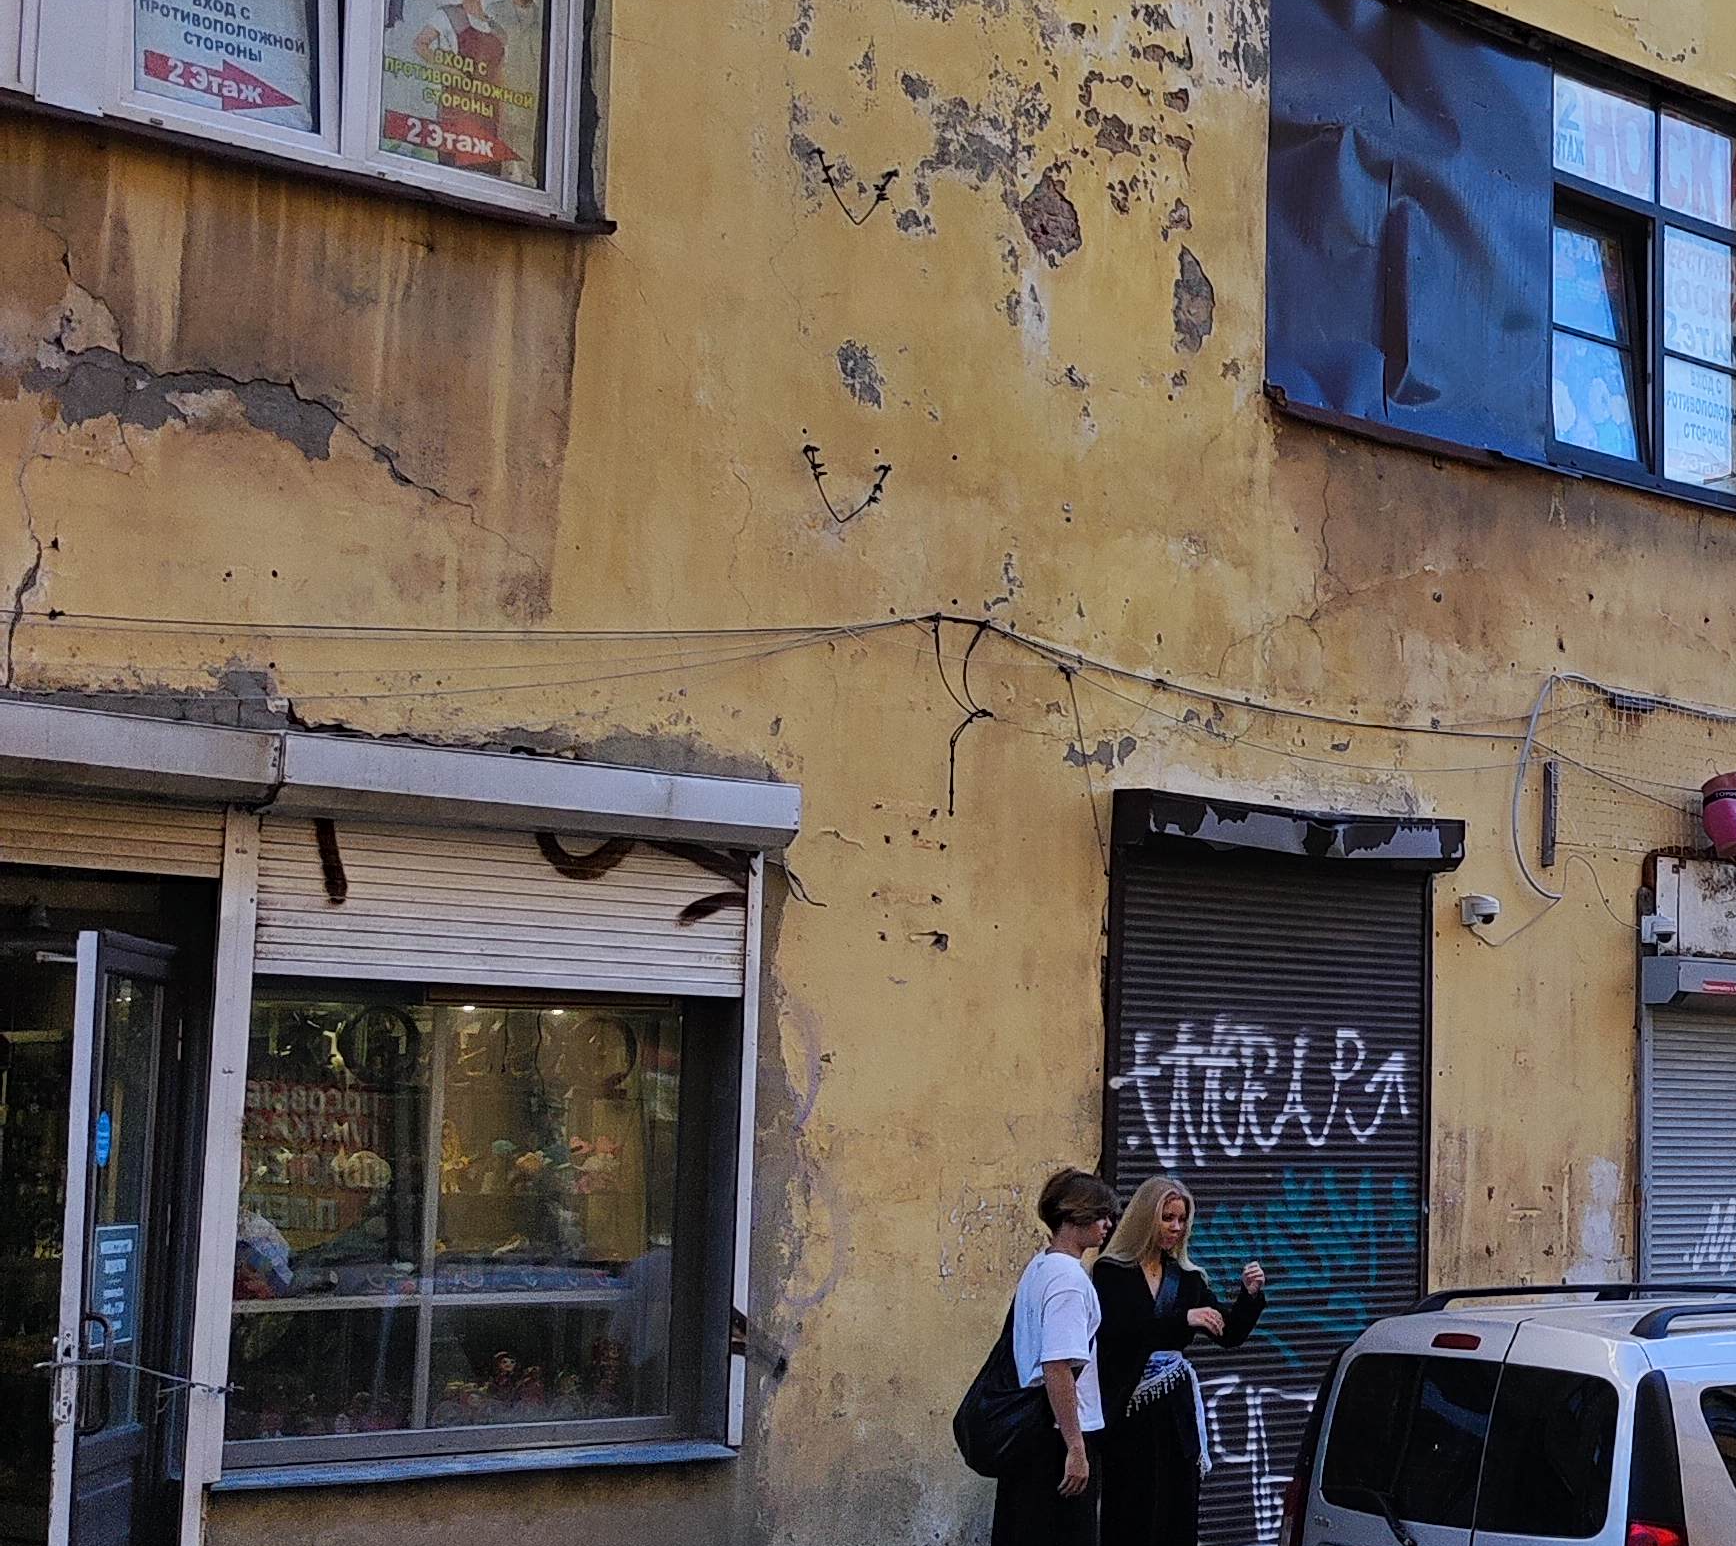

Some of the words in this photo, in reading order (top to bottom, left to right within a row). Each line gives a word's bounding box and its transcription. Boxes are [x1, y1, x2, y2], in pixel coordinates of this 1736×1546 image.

[240, 6, 251, 20] С
[183, 31, 262, 63] СТОРОНЫ
[434, 49, 474, 76] ВХОД
[478, 61, 487, 76] С
[167, 59, 184, 86] 2
[190, 66, 263, 104] Этаж
[384, 57, 535, 110] ПРОТИВОПОЛОЖНОЙ
[422, 86, 494, 119] СТОРОНЫ
[1557, 84, 1580, 131] 2
[406, 117, 422, 144] 2
[426, 123, 494, 159] Этаж
